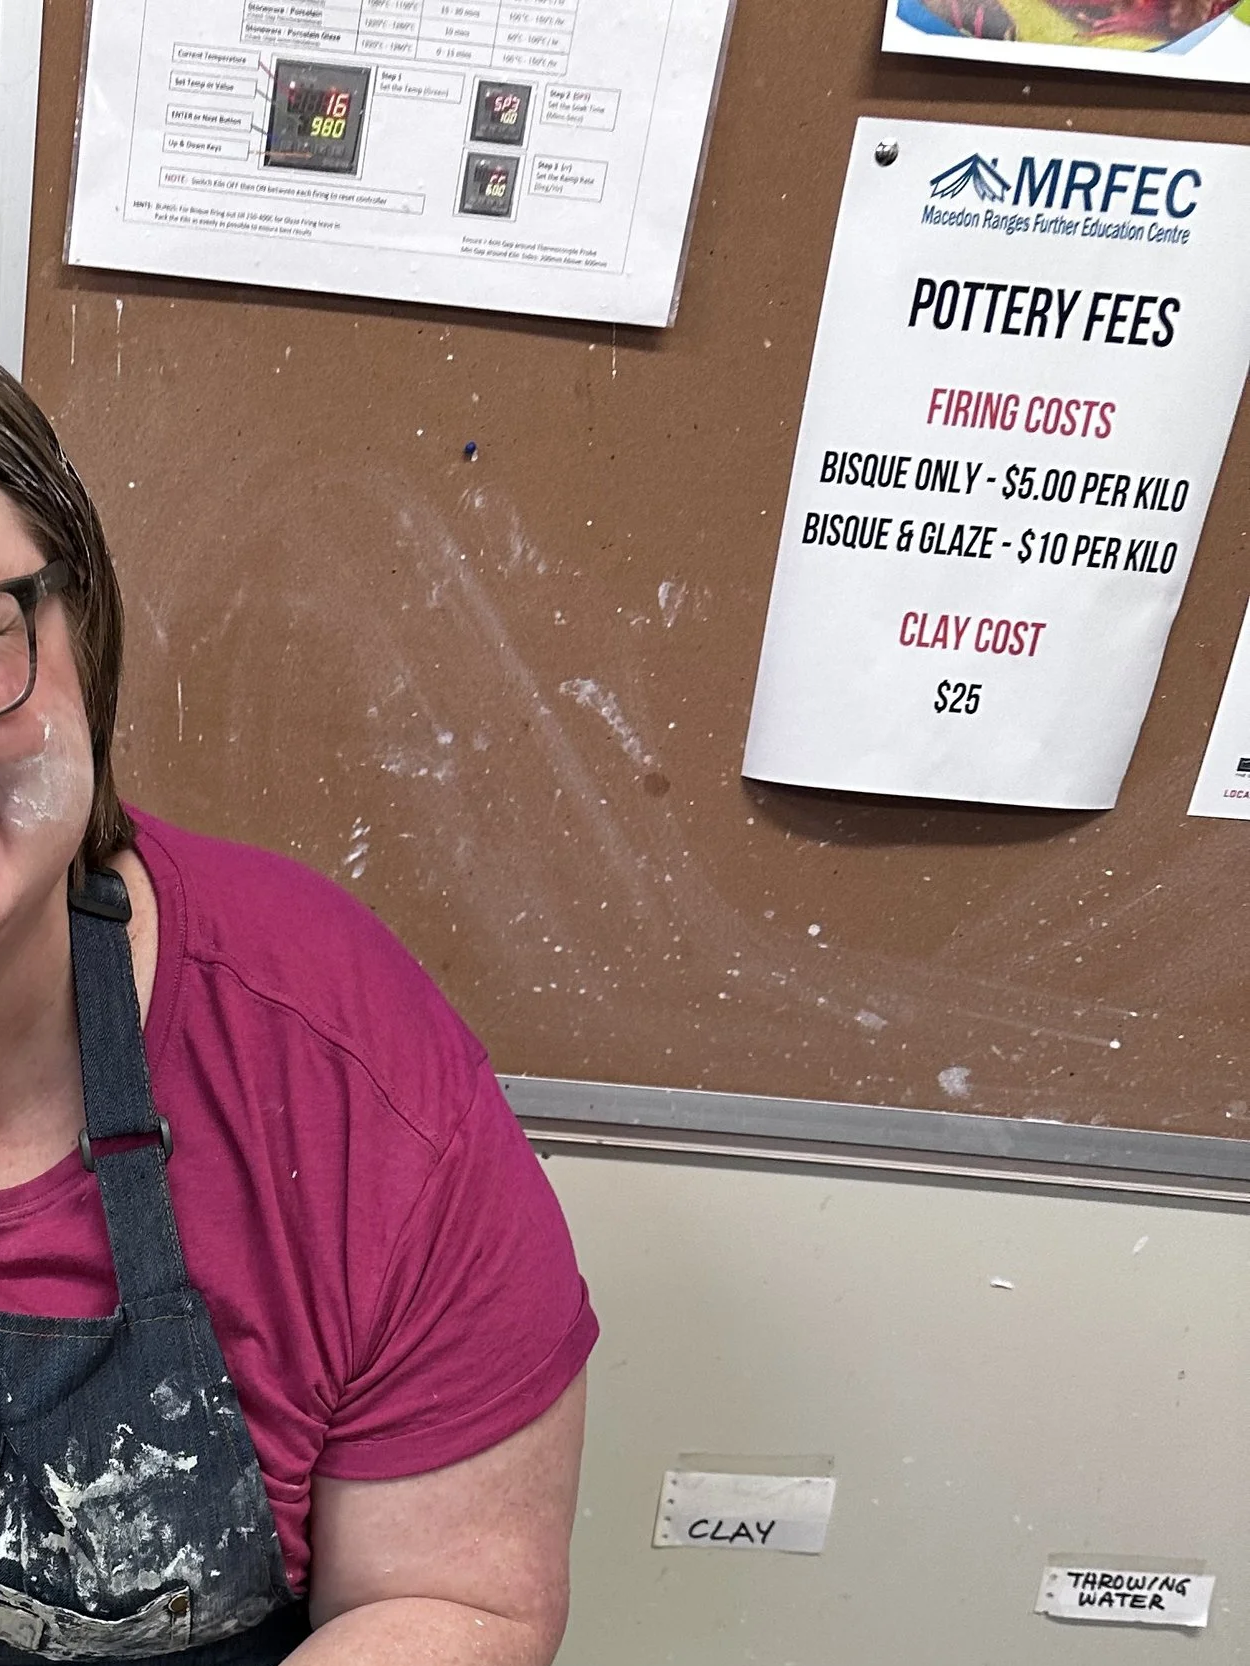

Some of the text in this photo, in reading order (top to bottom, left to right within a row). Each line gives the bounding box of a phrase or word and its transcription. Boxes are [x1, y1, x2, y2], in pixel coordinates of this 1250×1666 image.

[178, 48, 246, 65] Current Temperature
[382, 70, 396, 81] Step
[172, 110, 192, 120] ENTER
[326, 93, 349, 117] 16
[310, 116, 346, 138] 980
[169, 138, 177, 148] Up
[1012, 156, 1202, 219] MRFEC
[921, 205, 1191, 245] Macedon Ranges Further Education Centre
[908, 277, 1180, 348] POTTERY FEES
[927, 388, 1116, 439] FIRING COSTS
[820, 451, 911, 489] BISQUE
[915, 458, 982, 494] ONLY
[1002, 464, 1076, 502] $5.00
[1080, 472, 1131, 508] PER
[1133, 476, 1190, 512] KILO
[802, 512, 893, 550] BISQUE
[896, 519, 915, 552] &
[918, 521, 998, 559] GLAZE
[1017, 528, 1069, 565] $10
[1071, 535, 1121, 570] PER
[1123, 539, 1179, 574] KILO
[899, 611, 1047, 657] CLAY COST
[934, 679, 982, 714] $25
[688, 1519, 776, 1545] CLAY
[1067, 1572, 1191, 1597] THROWING
[1078, 1591, 1166, 1611] WATER
